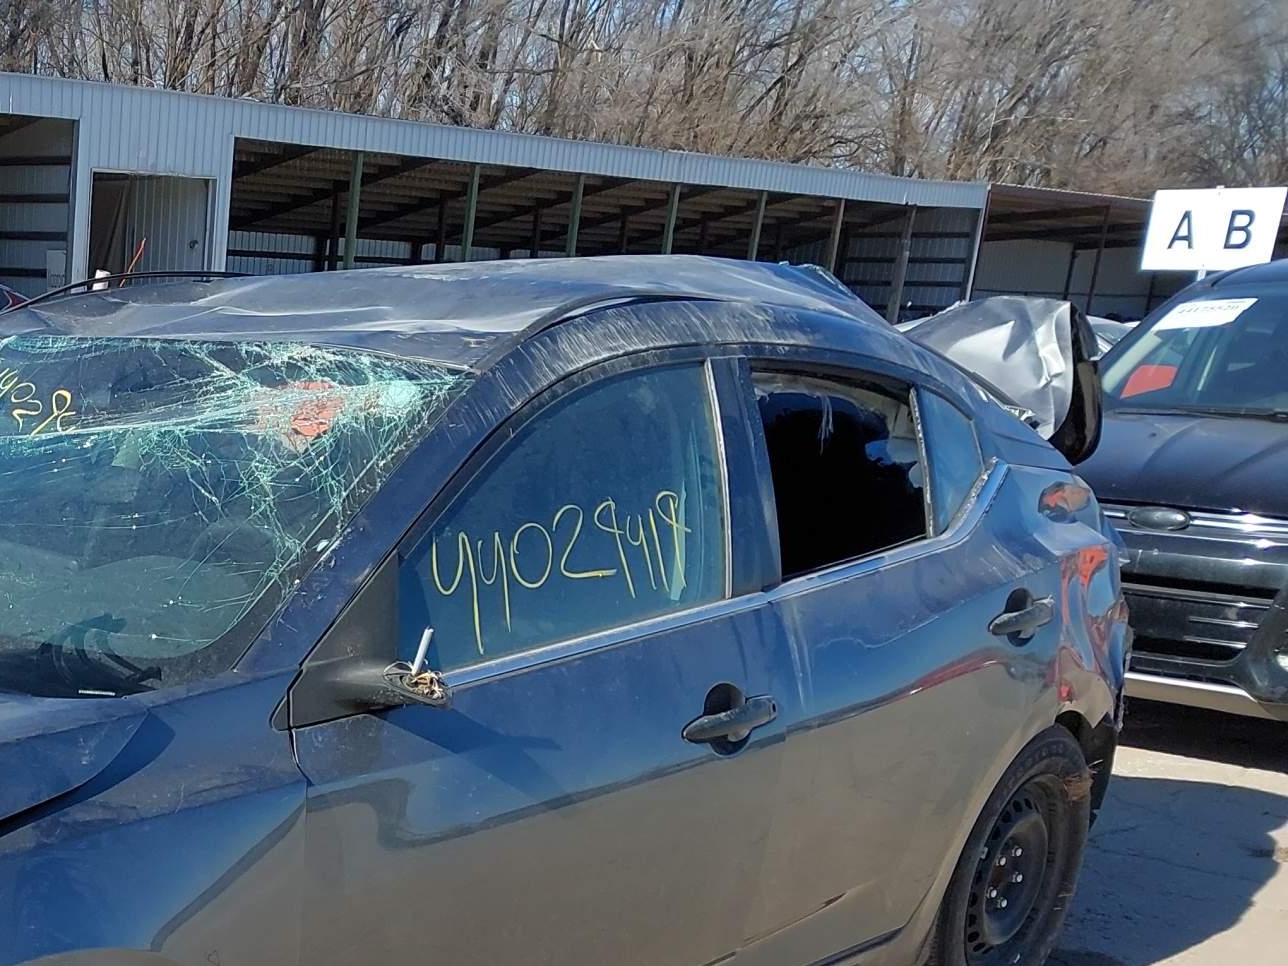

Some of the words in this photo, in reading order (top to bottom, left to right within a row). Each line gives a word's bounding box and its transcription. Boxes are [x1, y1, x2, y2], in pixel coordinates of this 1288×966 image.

[1166, 209, 1194, 250] A
[1223, 208, 1257, 250] B
[431, 489, 692, 656] 44029419
